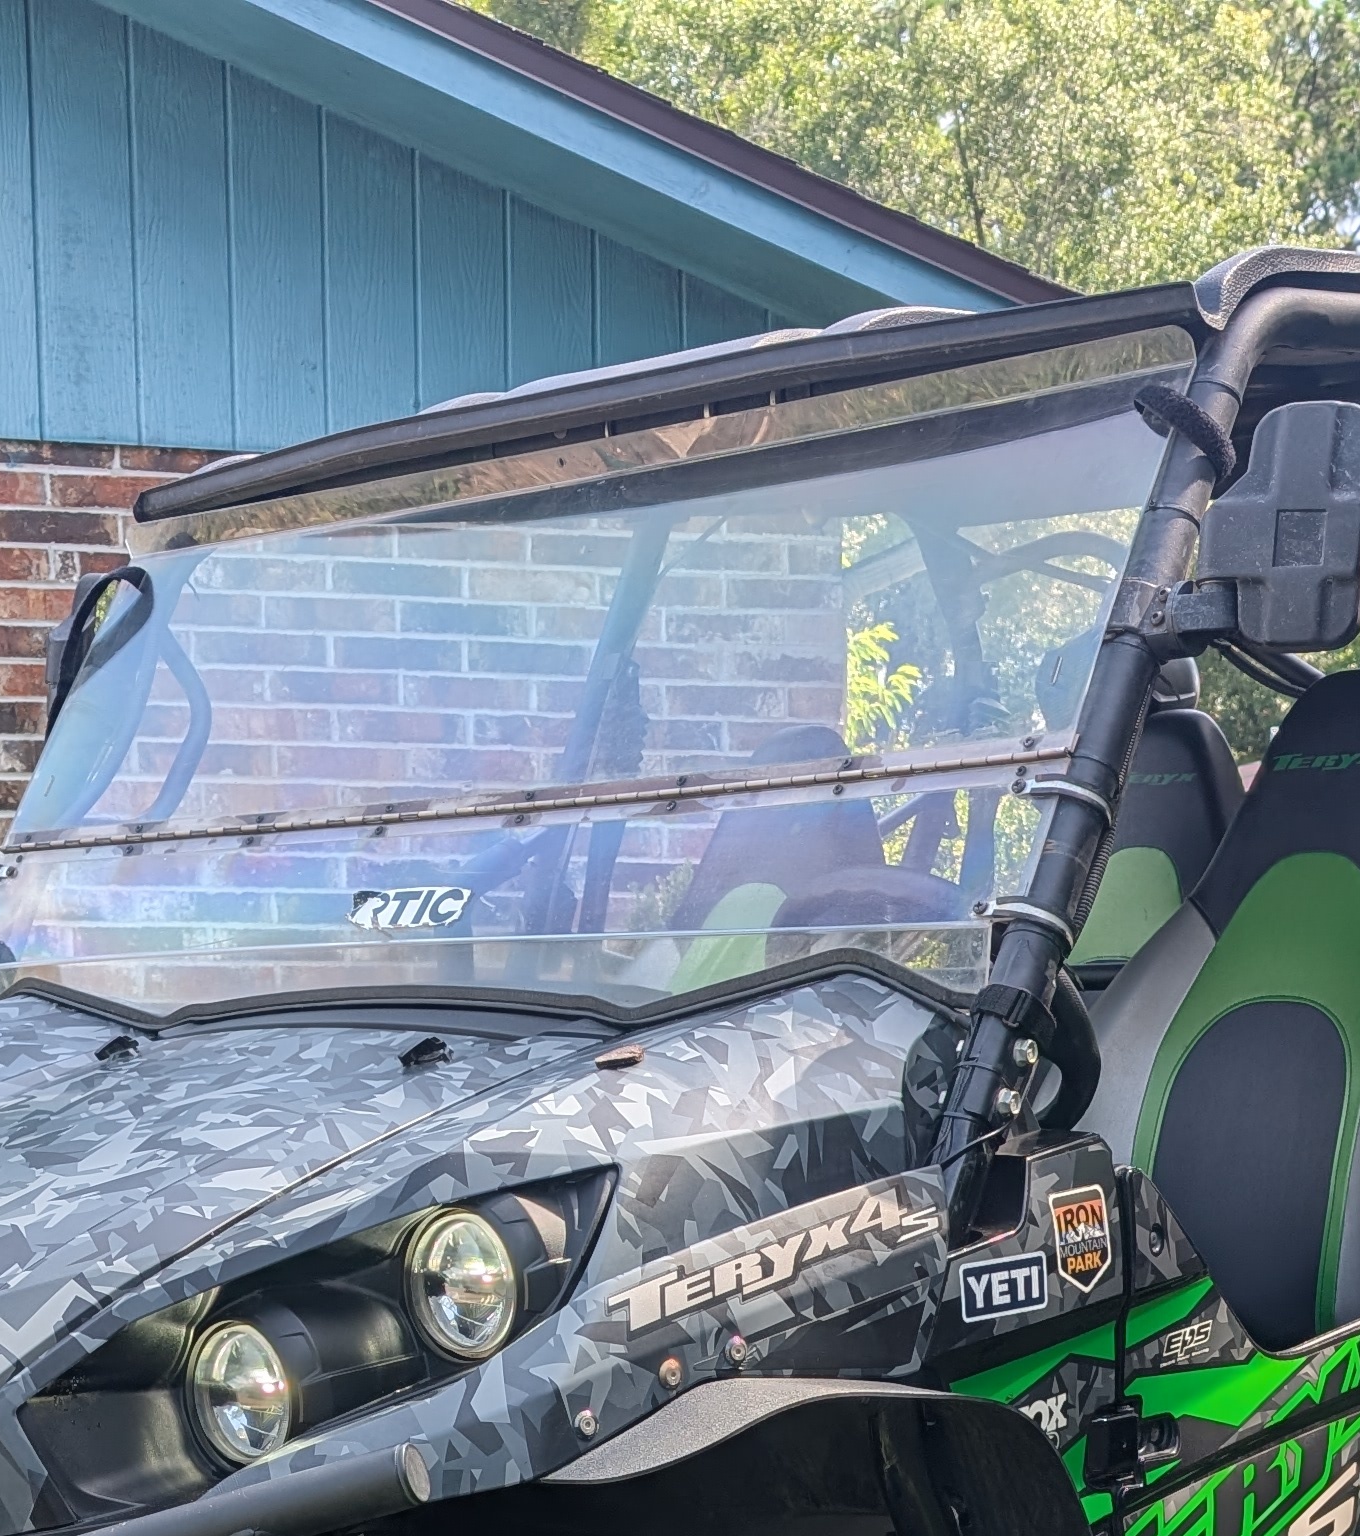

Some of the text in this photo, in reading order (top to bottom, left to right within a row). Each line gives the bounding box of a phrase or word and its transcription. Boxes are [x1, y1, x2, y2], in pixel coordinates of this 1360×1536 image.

[1056, 1204, 1104, 1245] IRON
[1059, 1237, 1107, 1259] MOUNTAIN
[1067, 1250, 1102, 1275] PARK
[967, 1265, 1040, 1309] YETI
[1163, 1320, 1212, 1357] EPS
